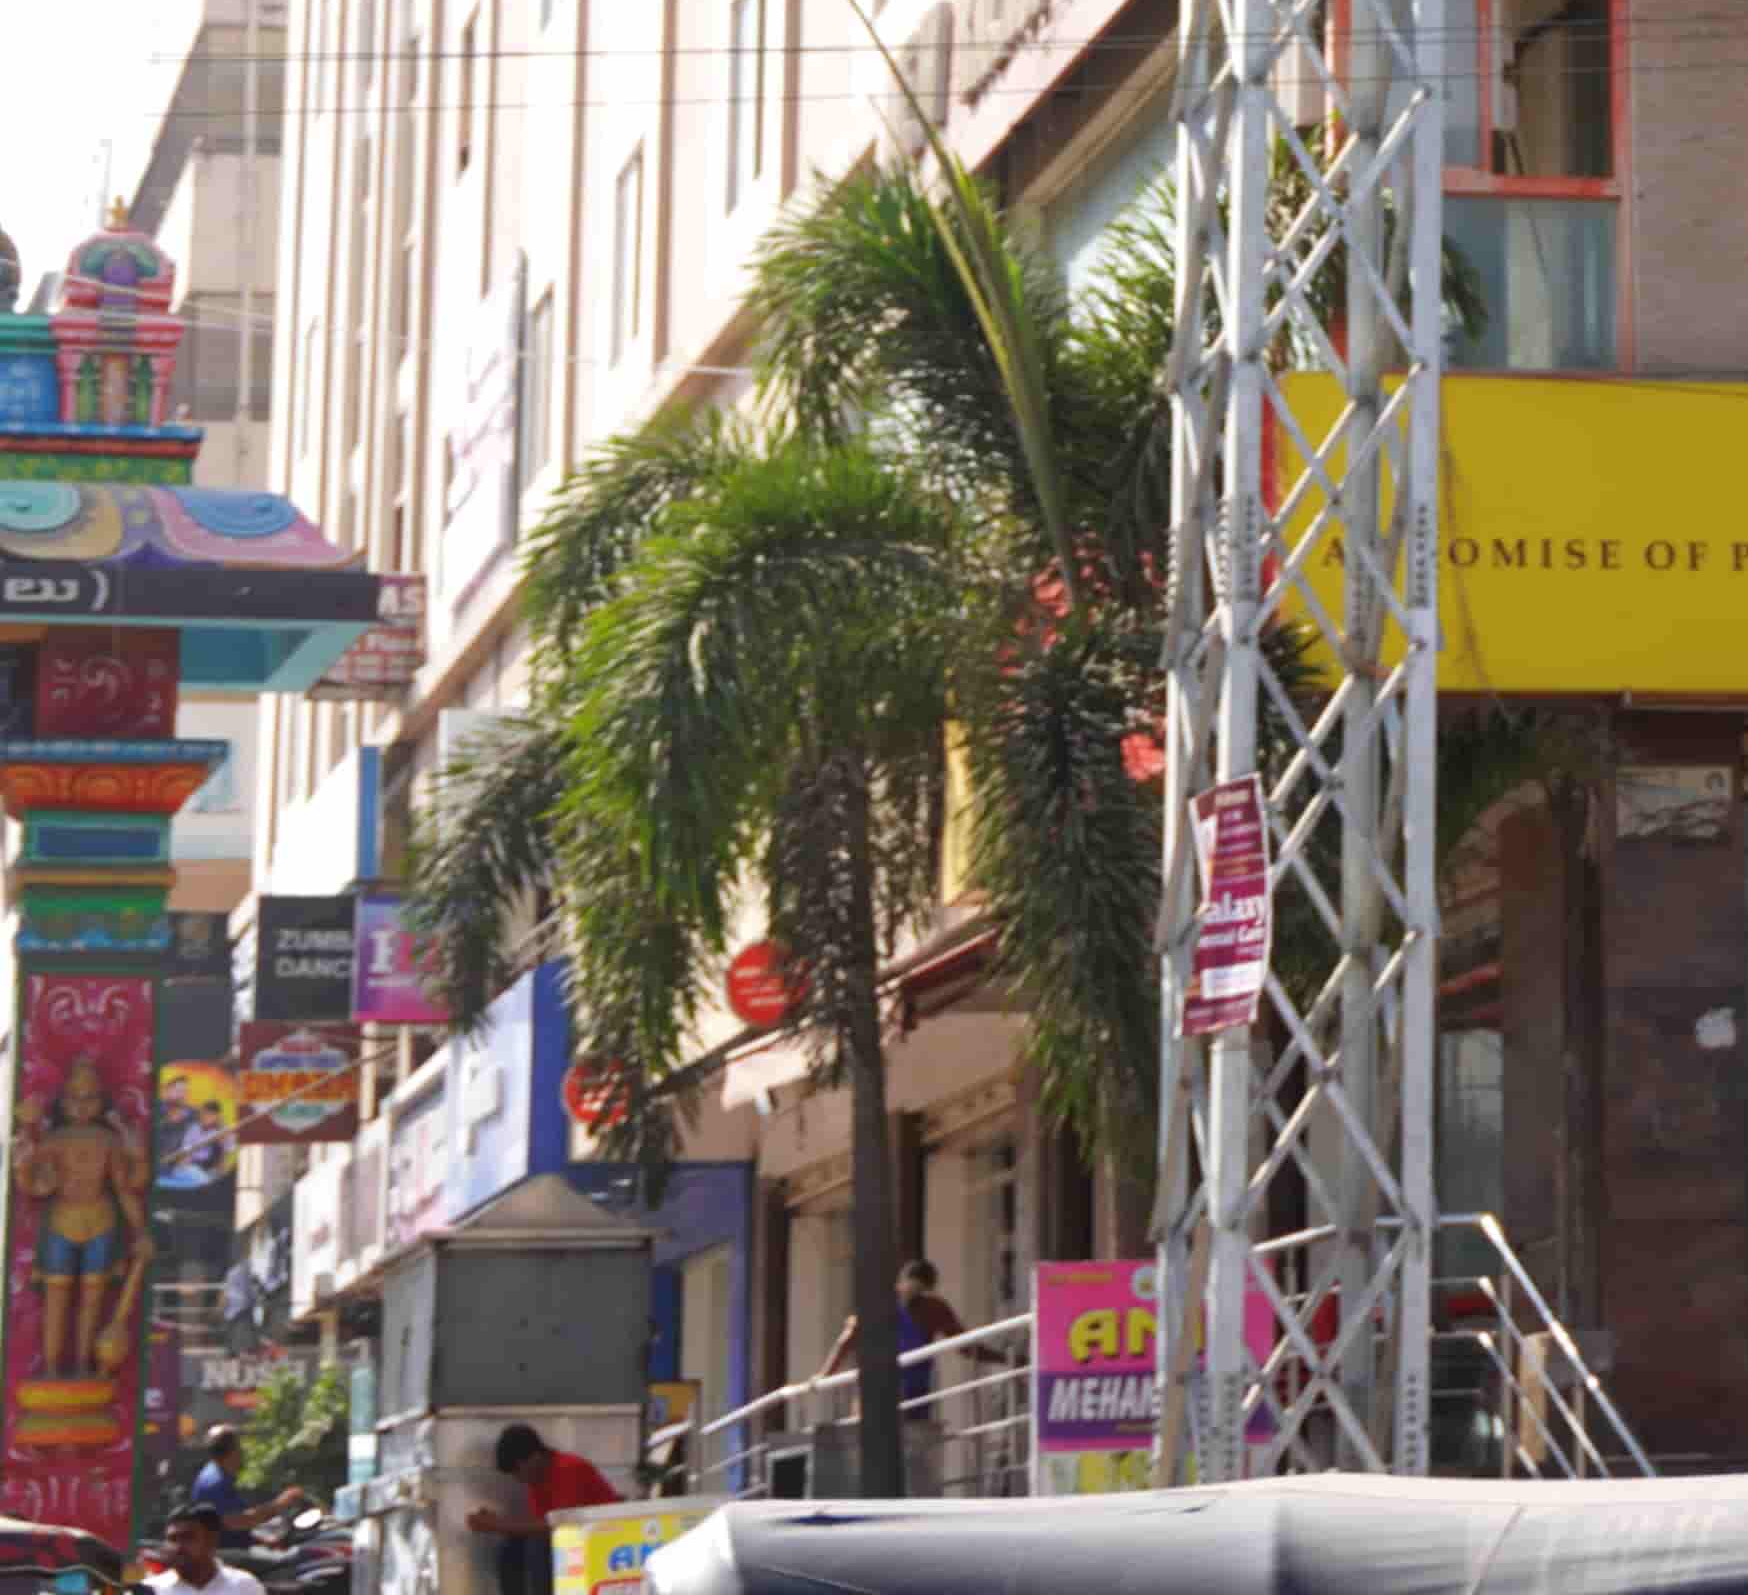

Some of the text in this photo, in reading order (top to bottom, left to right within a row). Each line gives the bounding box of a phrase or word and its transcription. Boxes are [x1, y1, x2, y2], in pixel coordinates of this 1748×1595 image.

[1448, 537, 1613, 572] OMISE
[1643, 538, 1710, 573] OF
[275, 928, 351, 952] ZUMB
[274, 958, 351, 979] DANC
